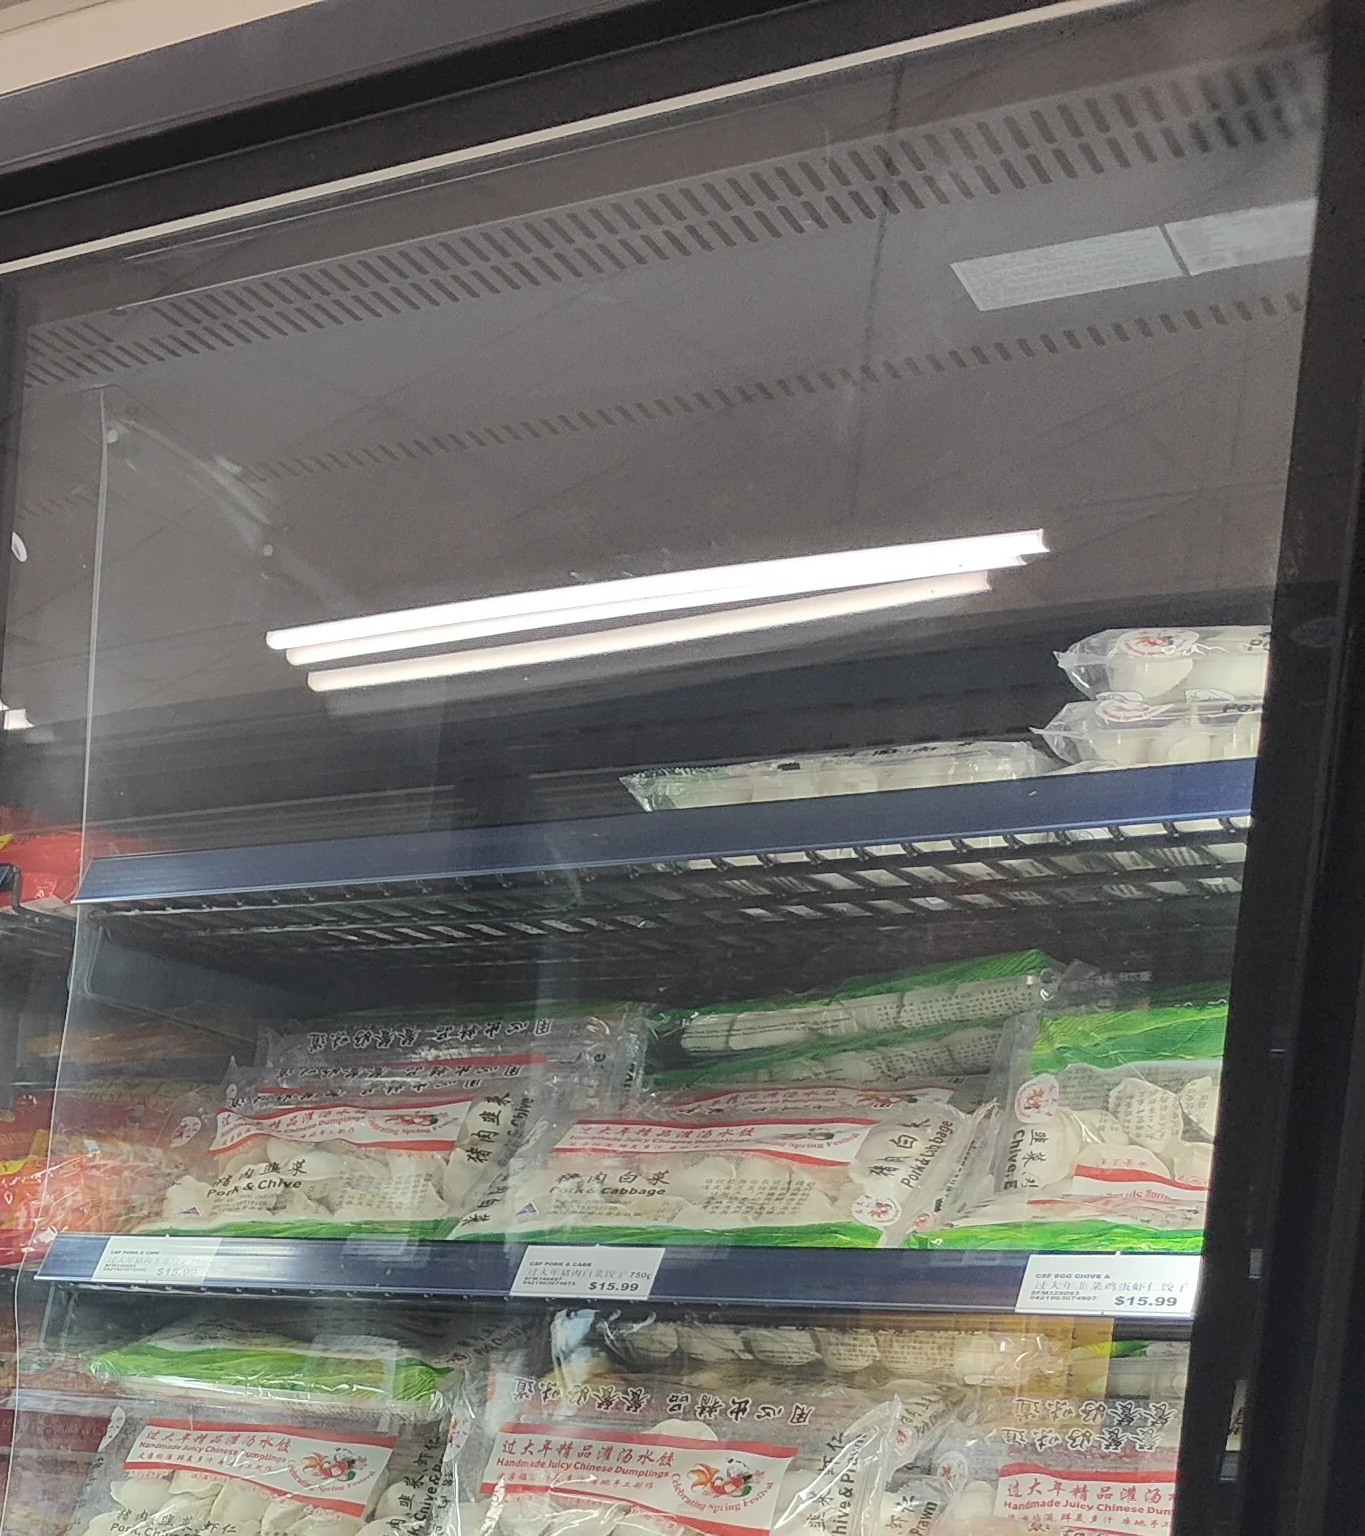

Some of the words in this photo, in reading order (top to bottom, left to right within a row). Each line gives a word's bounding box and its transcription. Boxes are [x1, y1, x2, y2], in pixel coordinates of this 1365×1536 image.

[258, 1176, 303, 1192] Chive
[600, 1184, 667, 1197] Cabbage
[588, 1281, 640, 1292] $15.99
[1114, 1295, 1179, 1307] $15.99
[666, 1390, 816, 1427] 用心出精品
[138, 1440, 181, 1455] Handmade
[183, 1444, 205, 1457] Juicy
[205, 1446, 239, 1458] Chinese
[501, 1439, 676, 1468] 过大年精品灌汤水饺
[496, 1457, 546, 1469] Handmade
[547, 1459, 572, 1471] Juicy
[573, 1461, 613, 1473] Chinese
[614, 1465, 670, 1478] Dumplings
[670, 1473, 707, 1511] Celebrating
[707, 1501, 742, 1514] Spring
[743, 1481, 775, 1508] Festival
[1004, 1498, 1060, 1511] Handmade
[1063, 1500, 1094, 1514] Juicy
[1096, 1503, 1145, 1515] Chinese
[913, 1500, 938, 1536] Prawn
